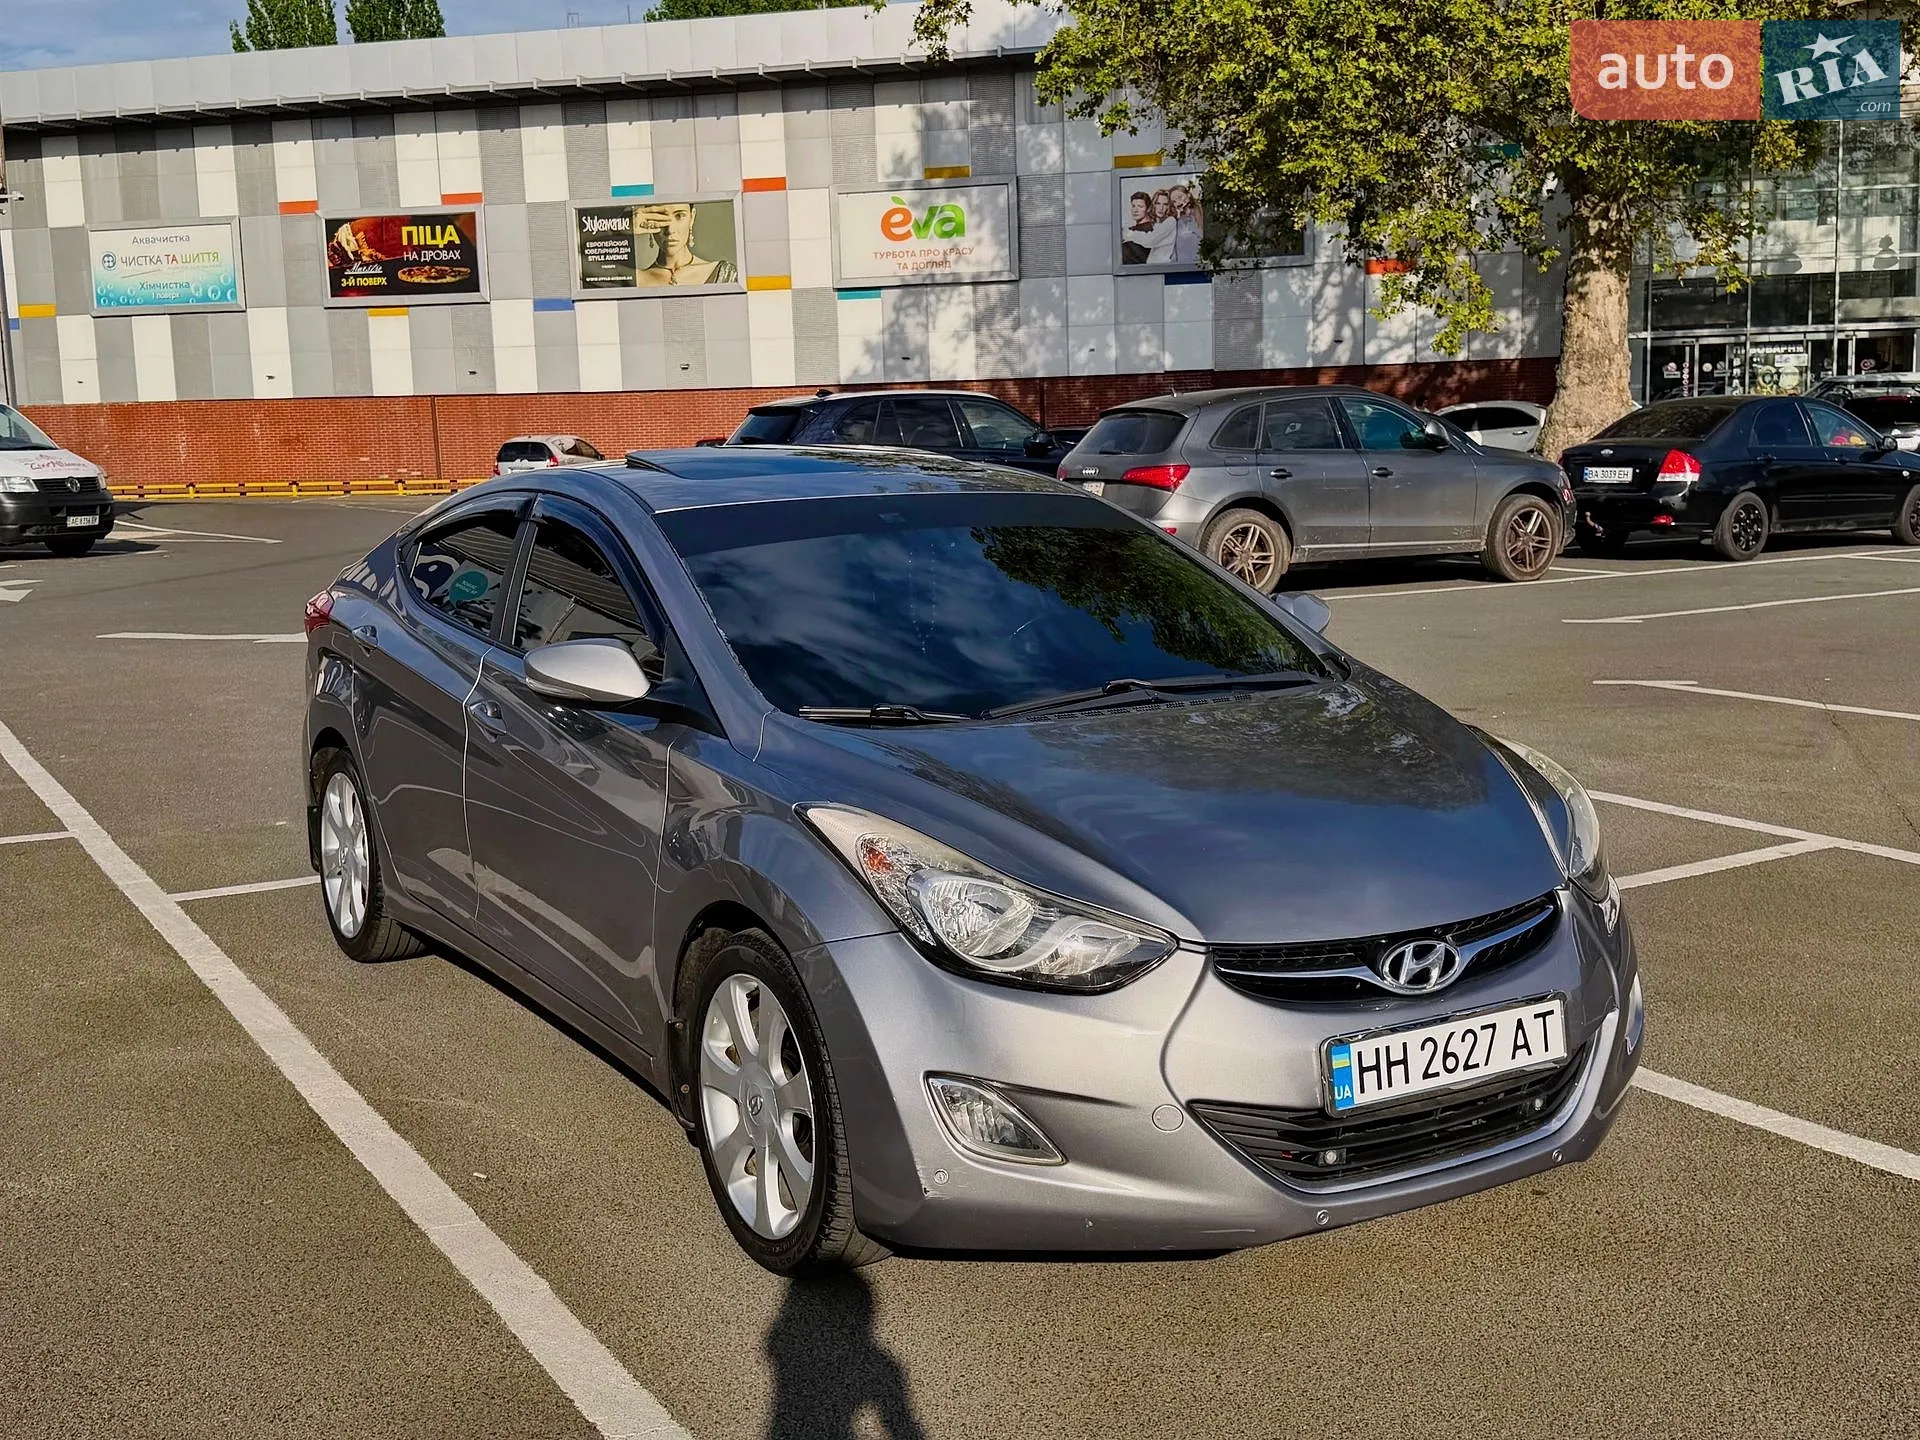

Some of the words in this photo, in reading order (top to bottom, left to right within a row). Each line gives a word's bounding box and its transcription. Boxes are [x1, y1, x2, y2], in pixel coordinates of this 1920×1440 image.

[132, 234, 190, 246] Аквачистка
[401, 225, 461, 248] ПІЦА
[120, 255, 163, 267] ЧИСТКА
[164, 254, 178, 265] ТА
[181, 251, 220, 264] ШИТТЯ
[404, 251, 419, 261] НА
[421, 249, 461, 262] ДРОВАХ
[873, 251, 916, 260] ТУРБОТА
[919, 249, 940, 258] ПРО
[942, 247, 975, 257] КРАСУ
[897, 262, 909, 271] ТА
[912, 260, 952, 271] ДОГЛЯД
[139, 281, 191, 291] Хімчистка
[341, 277, 355, 287] 3-Й
[356, 276, 387, 287] ПОВЕРХ
[1357, 1041, 1410, 1094] HH
[1420, 1022, 1497, 1080] 2627
[1511, 1009, 1555, 1060] AT
[1334, 1083, 1353, 1100] UA
